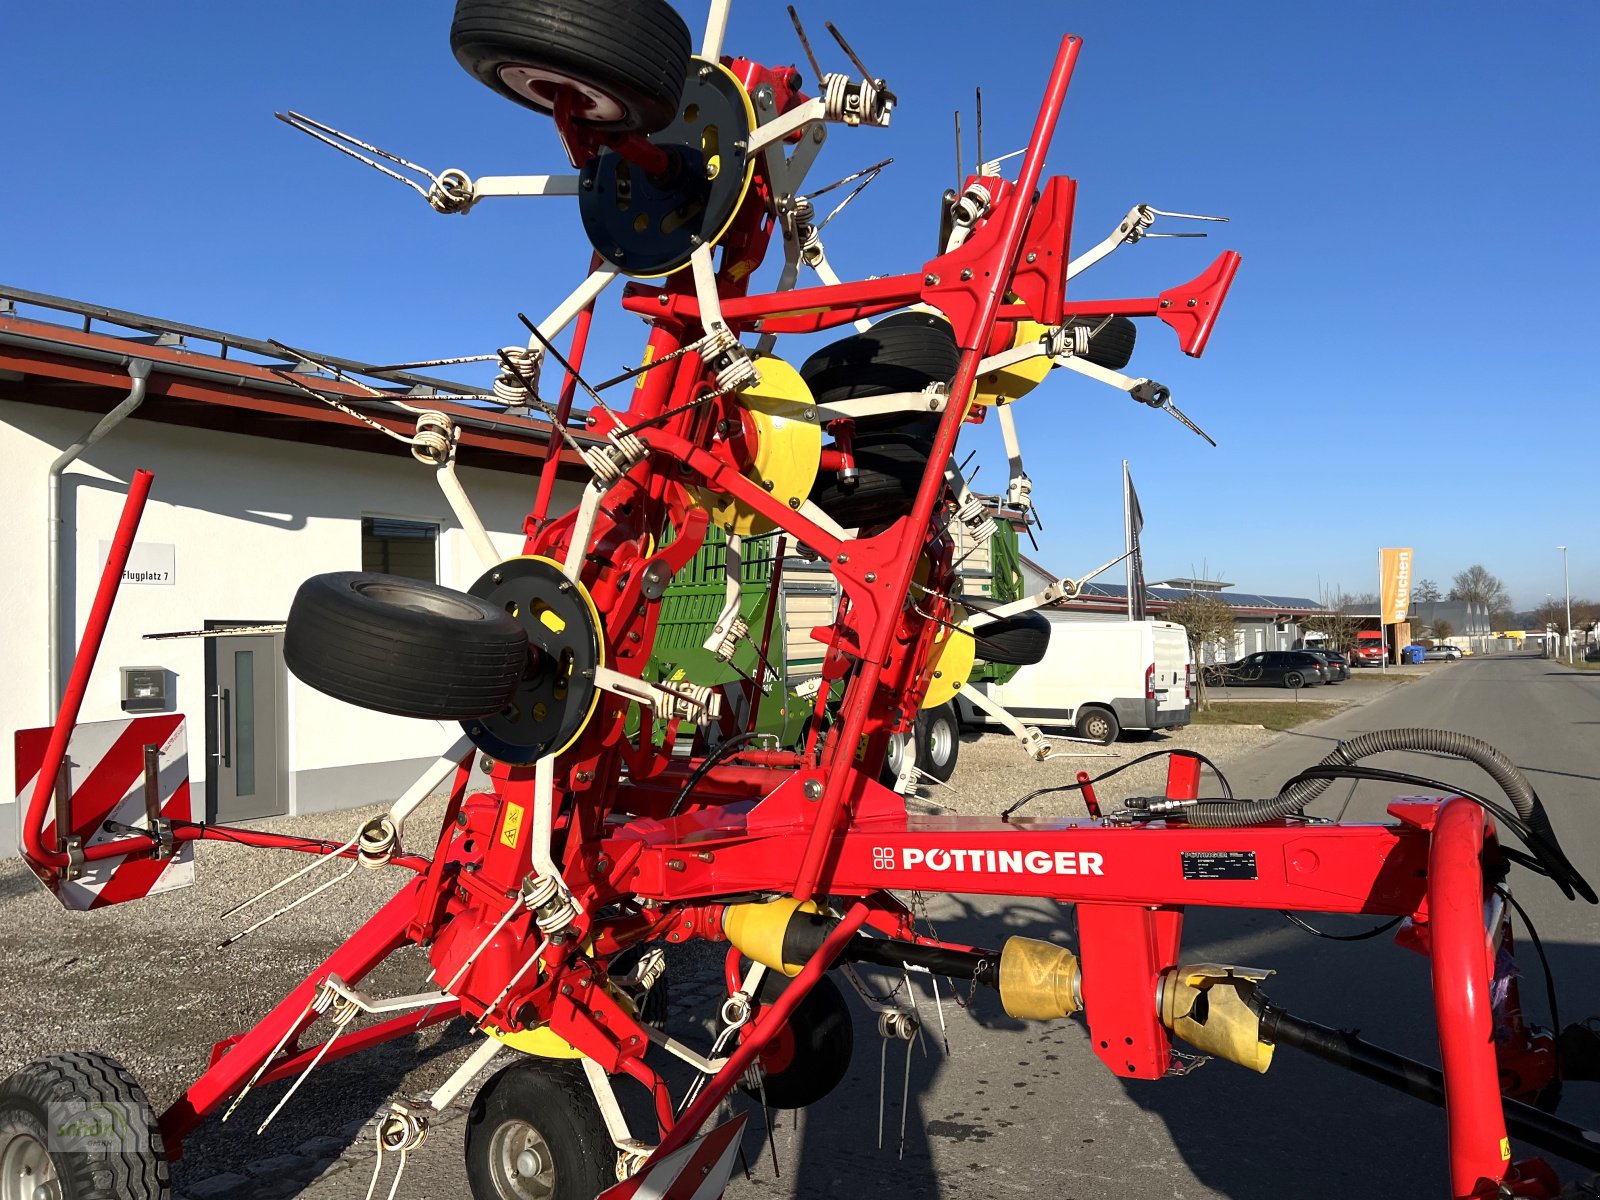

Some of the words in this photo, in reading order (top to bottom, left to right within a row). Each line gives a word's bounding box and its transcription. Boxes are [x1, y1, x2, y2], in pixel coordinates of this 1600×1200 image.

[122, 570, 161, 582] Flugplatz
[164, 572, 169, 580] 7
[903, 848, 1104, 876] PÖTTINGER
